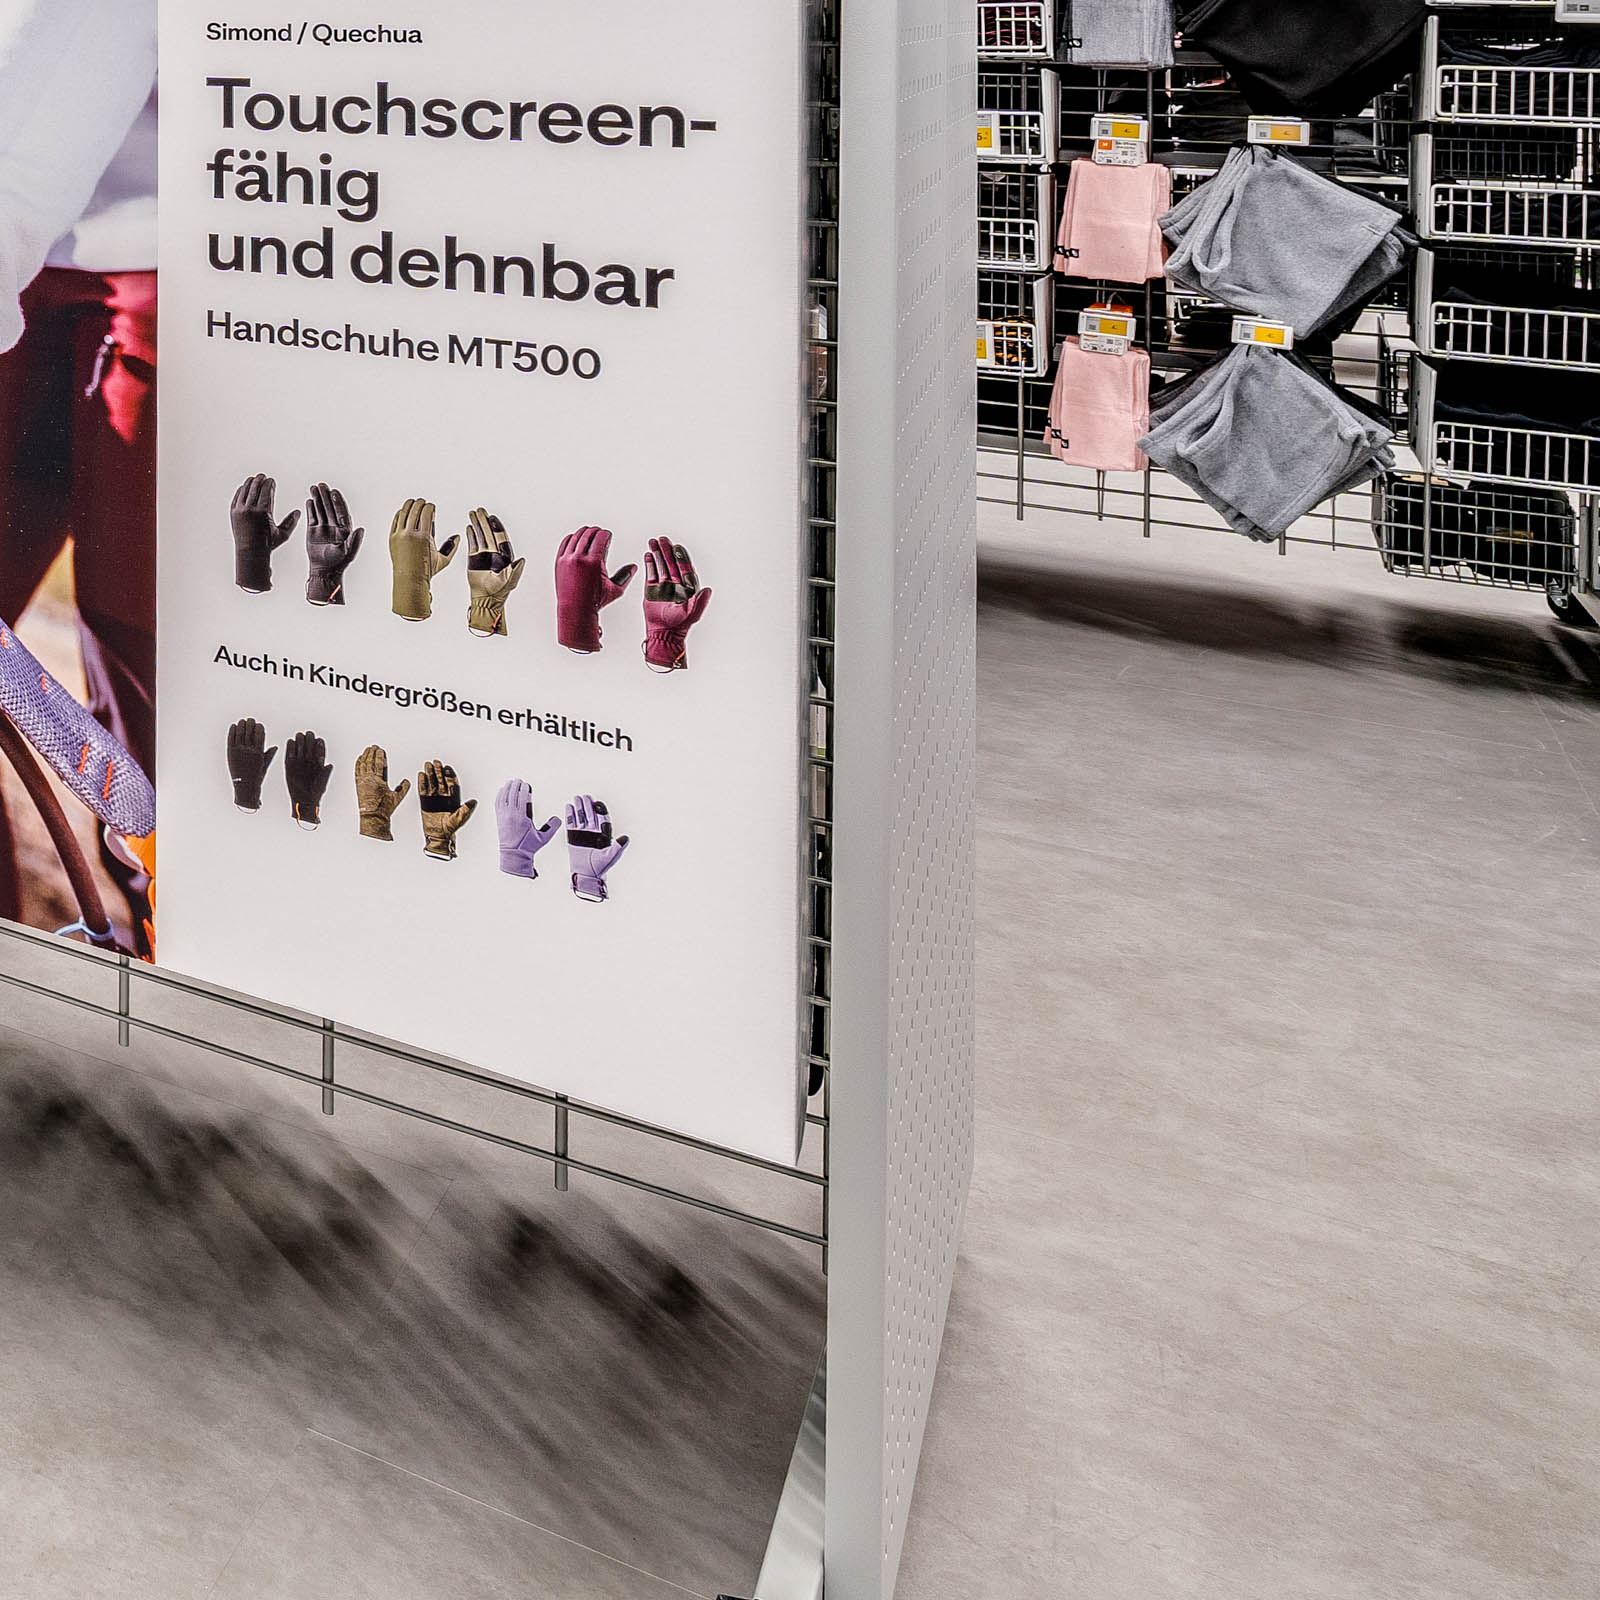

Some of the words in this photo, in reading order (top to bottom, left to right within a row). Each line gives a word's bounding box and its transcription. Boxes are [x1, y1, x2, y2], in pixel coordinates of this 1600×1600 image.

[206, 22, 292, 41] Simond
[296, 21, 308, 45] /
[312, 23, 423, 46] Quechua
[206, 77, 718, 149] Touchscreen-
[206, 149, 379, 222] fähig
[208, 227, 334, 280] und
[351, 231, 675, 309] dehnbar
[206, 309, 440, 362] Handschuhe
[448, 333, 602, 381] MT500
[213, 645, 278, 677] Auch
[283, 656, 304, 681] in
[309, 662, 492, 721] Kindergrößen
[497, 706, 633, 752] erhältlich
